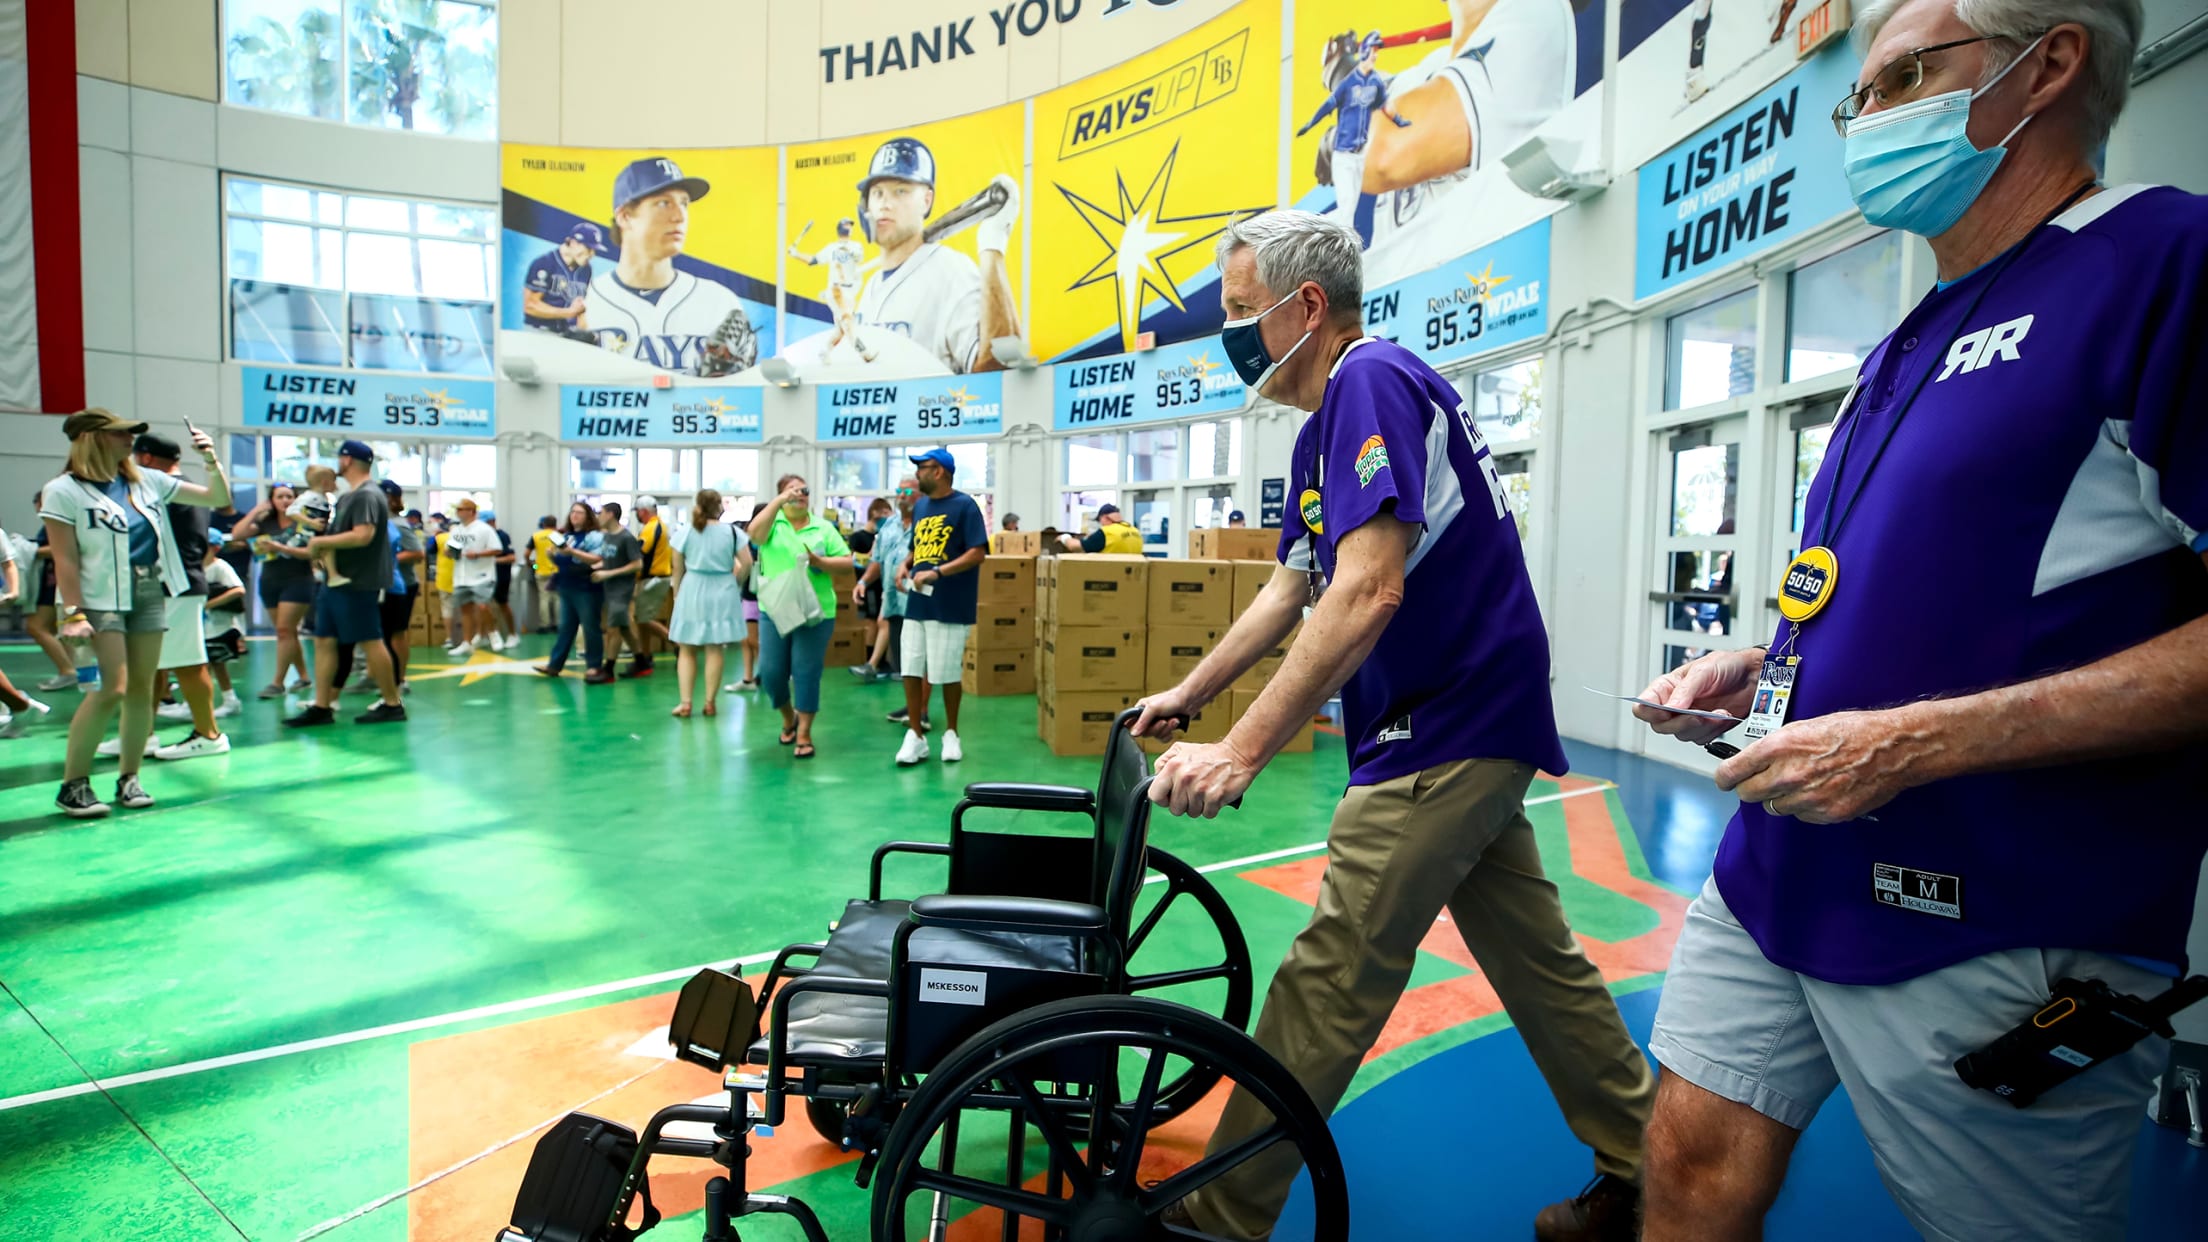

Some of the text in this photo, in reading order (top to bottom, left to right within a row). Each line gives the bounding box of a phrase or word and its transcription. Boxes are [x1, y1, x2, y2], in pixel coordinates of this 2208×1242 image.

[1799, 0, 1830, 52] EXIT
[820, 0, 1081, 84] THANK YOU
[1071, 66, 1197, 146] RAYS UP
[1663, 85, 1800, 206] LISTEN
[1677, 152, 1778, 220] ON YOUR WAY
[1662, 166, 1797, 280] HOME
[1454, 281, 1487, 304] RADIO
[1426, 302, 1483, 351] 95.3
[1486, 280, 1540, 318] WDAE
[264, 374, 356, 395] LISTEN
[1069, 360, 1136, 389] LISTEN
[576, 390, 649, 407] LISTEN
[832, 386, 897, 406] LISTEN
[1157, 379, 1201, 408] 95.3
[266, 403, 356, 426] HOME
[385, 406, 440, 426] 95.3
[918, 407, 960, 429] 95.3
[1069, 394, 1135, 423] HOME
[577, 418, 649, 437] HOME
[672, 415, 718, 434] 95.3
[832, 415, 897, 437] HOME
[1356, 446, 1387, 475] Tropica
[1787, 571, 1806, 588] 50
[1802, 576, 1822, 594] 50
[1760, 661, 1794, 687] RAYS
[1774, 698, 1783, 714] C
[1876, 879, 1900, 890] TEAM
[1915, 873, 1941, 882] ADULT
[1919, 880, 1938, 900] M
[1901, 896, 1959, 916] HOLLOWAY
[1995, 1084, 2015, 1096] 65
